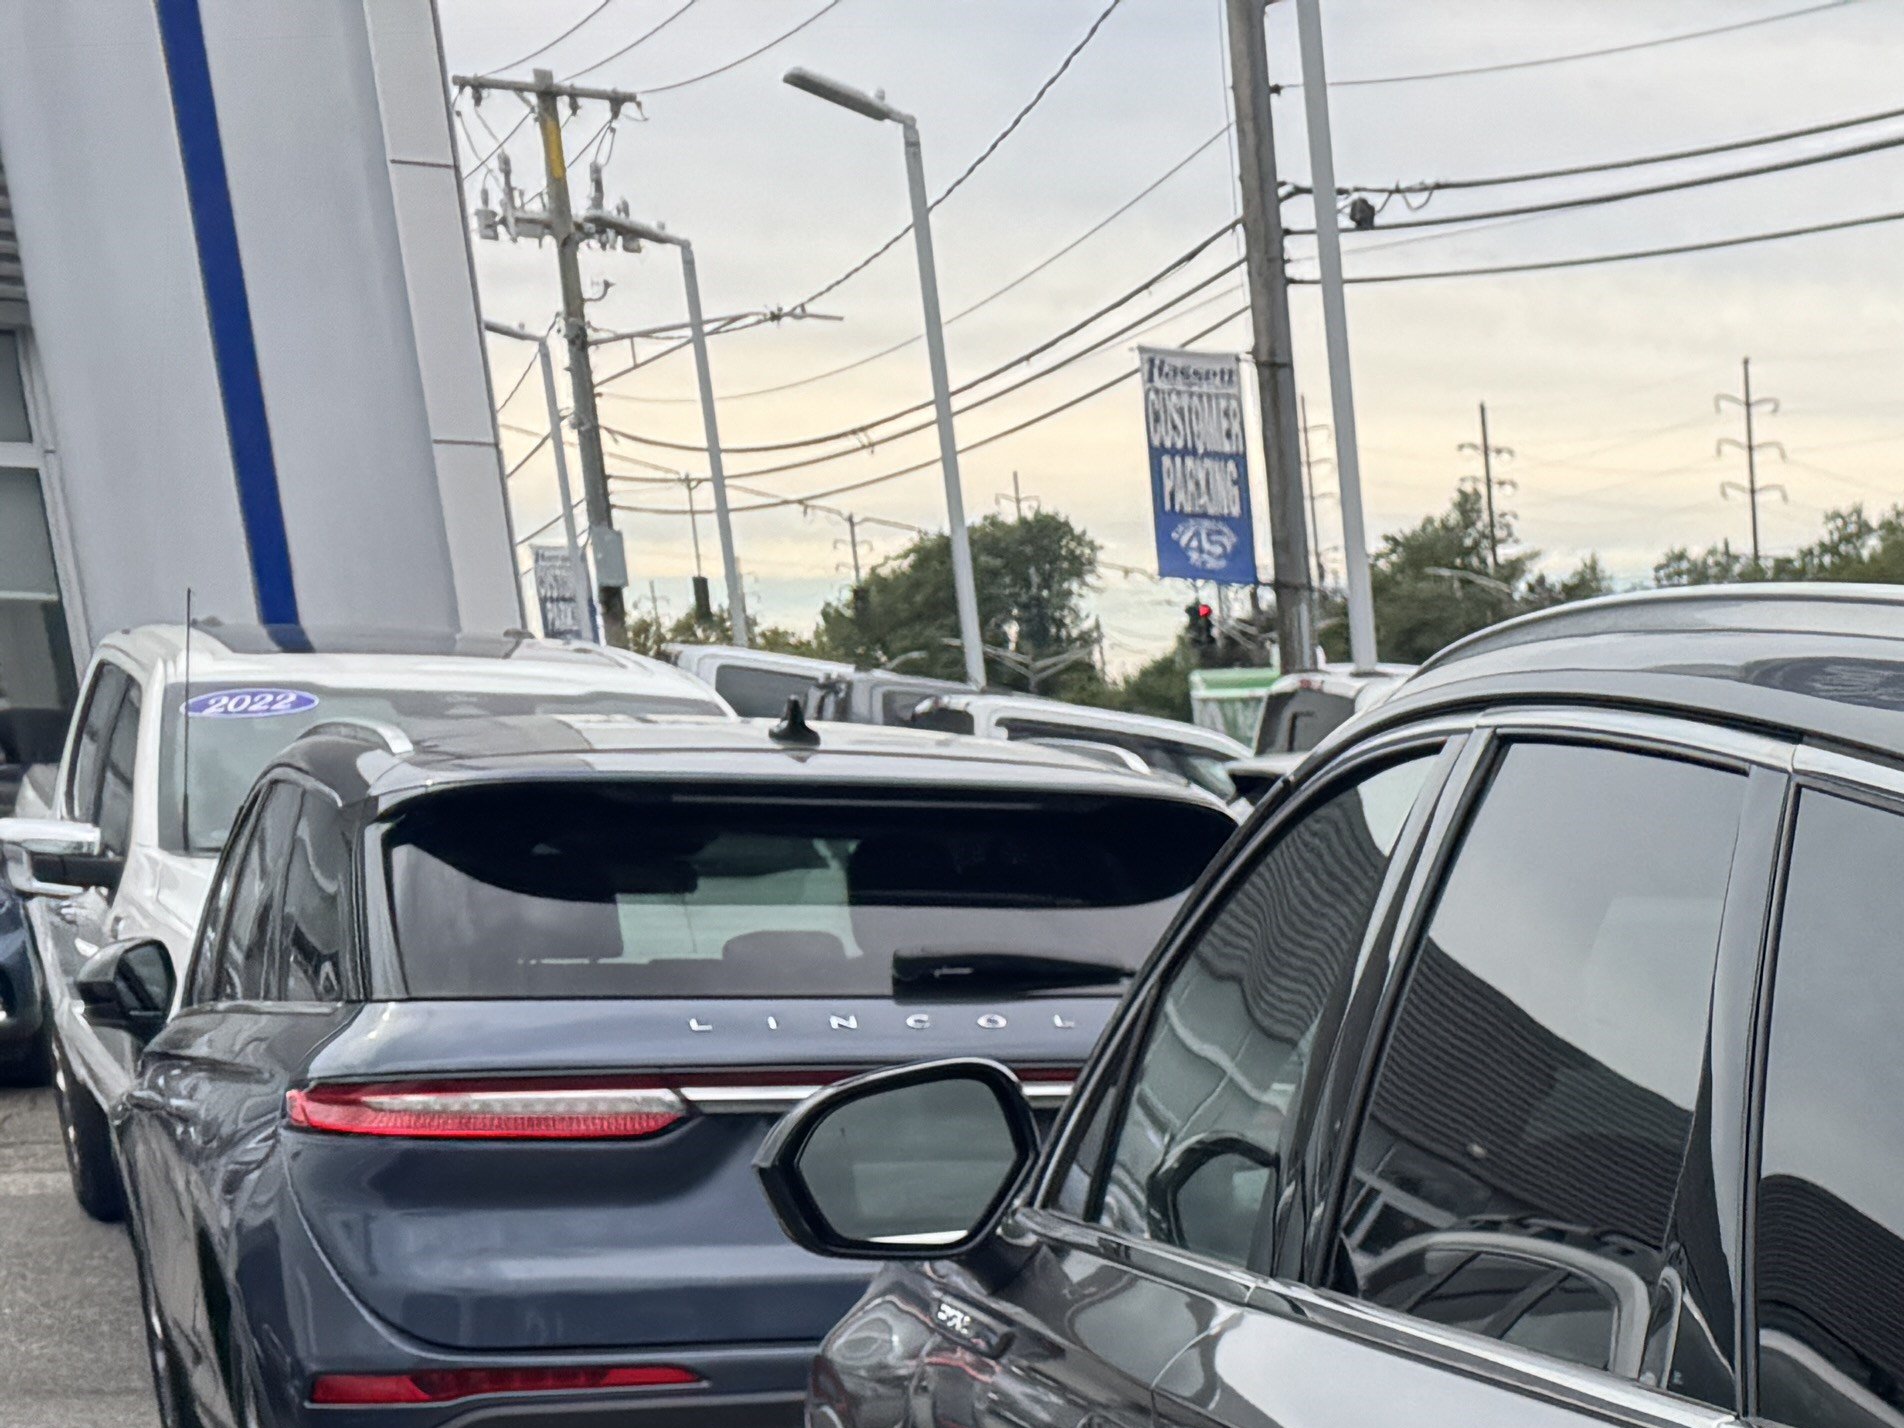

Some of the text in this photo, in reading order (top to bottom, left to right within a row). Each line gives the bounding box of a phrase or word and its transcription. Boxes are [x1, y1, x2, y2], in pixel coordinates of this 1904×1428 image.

[1149, 391, 1243, 453] CUSTOMER
[1161, 455, 1241, 516] PARKING
[201, 690, 298, 715] 2022
